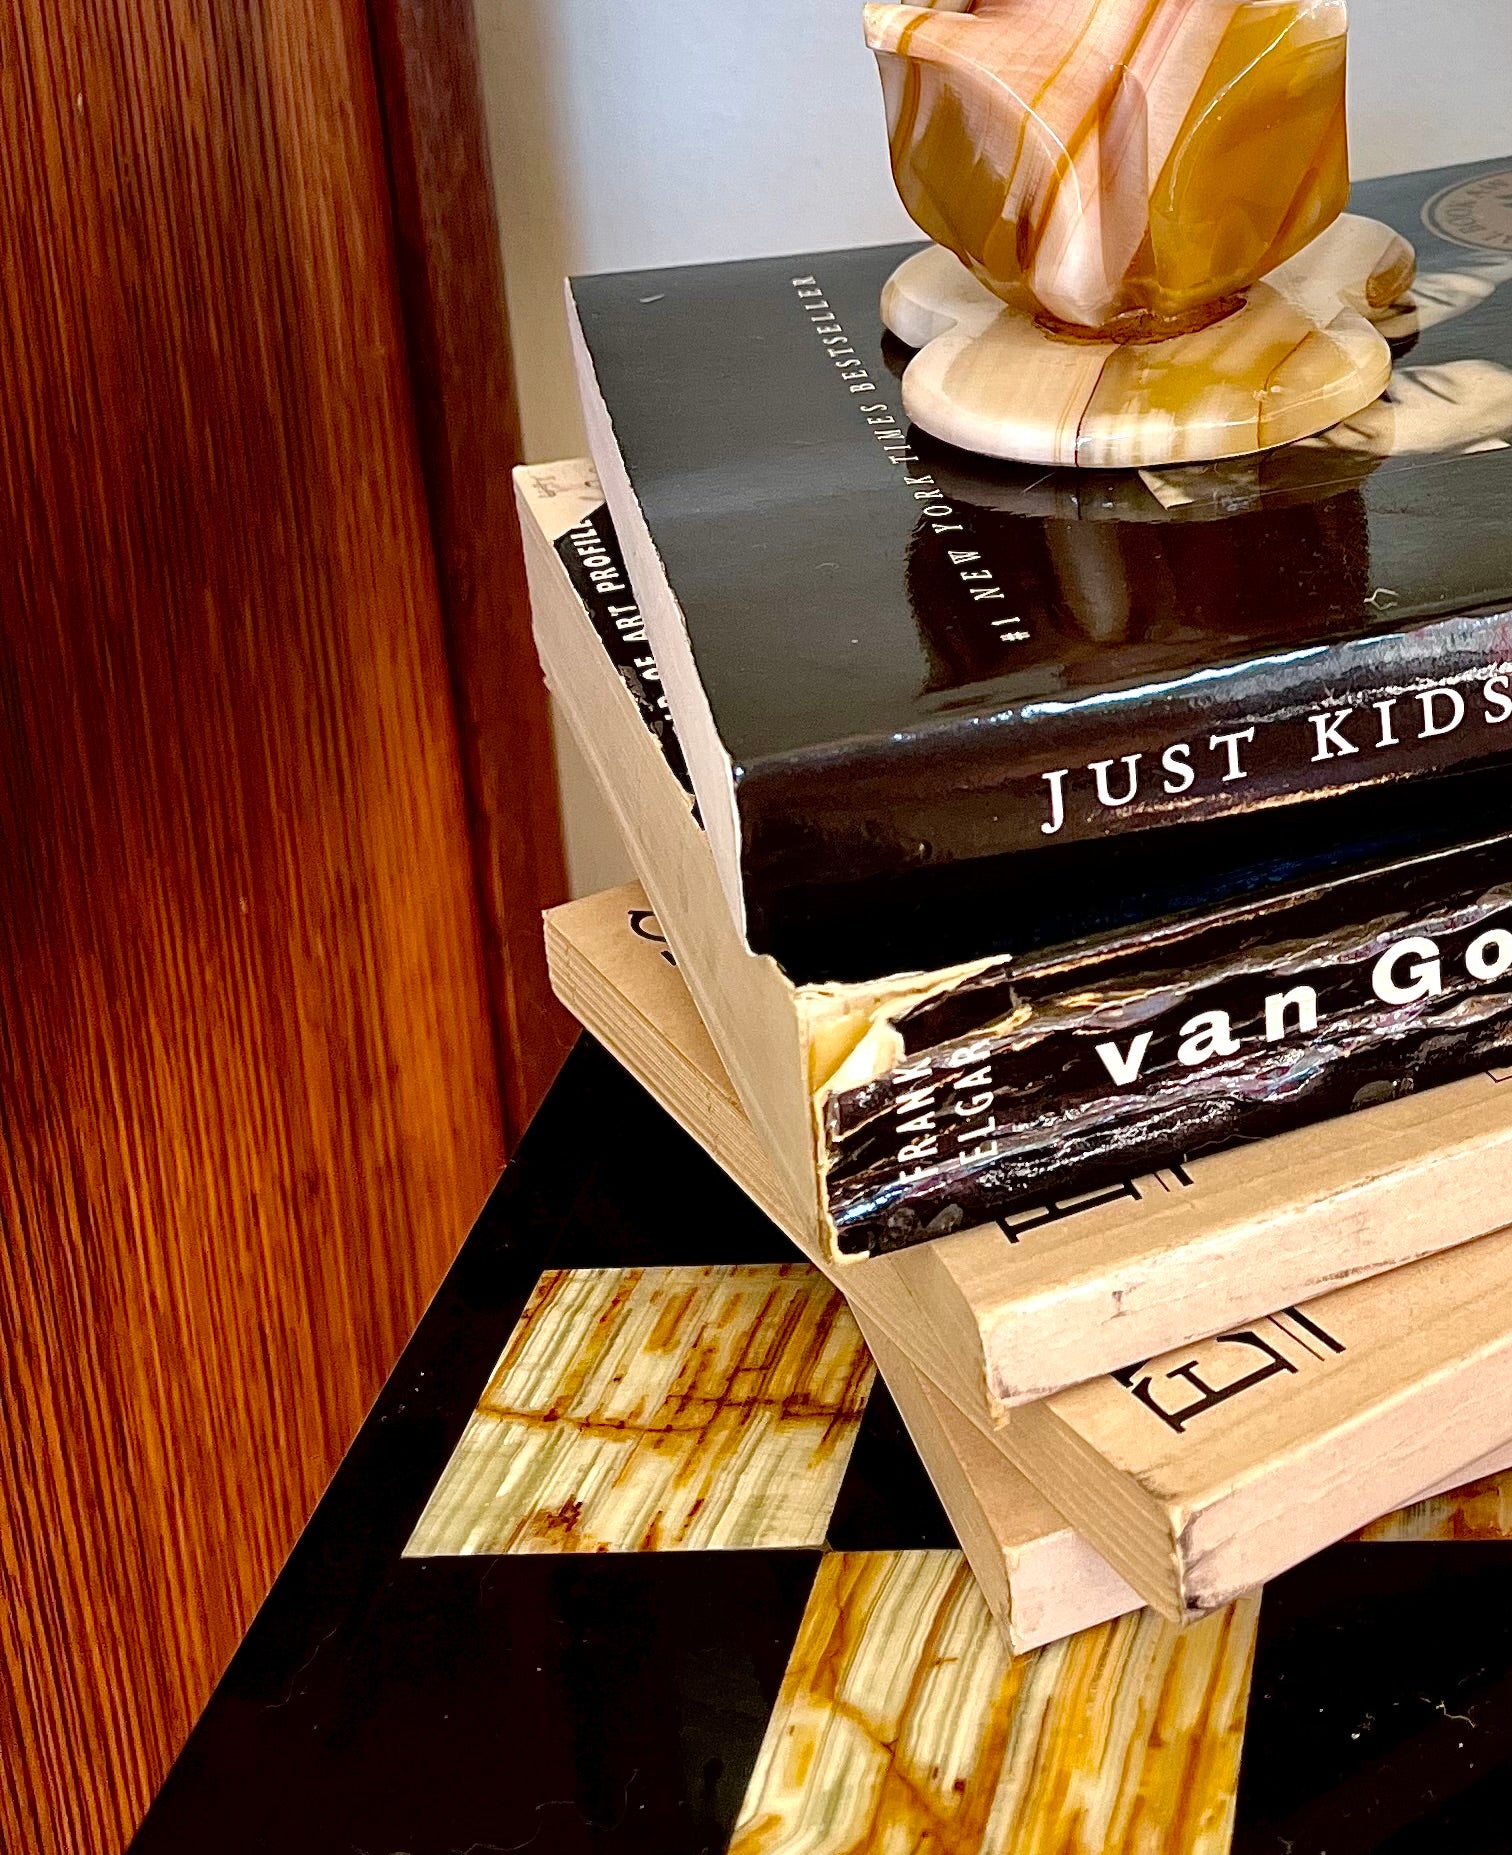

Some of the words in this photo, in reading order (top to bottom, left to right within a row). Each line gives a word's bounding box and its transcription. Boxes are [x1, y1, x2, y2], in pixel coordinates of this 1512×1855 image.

[792, 275, 877, 394] BESTSELLER
[860, 403, 920, 465] TIMES
[903, 475, 964, 534] YORK
[947, 549, 1006, 601] NEW
[607, 605, 648, 642] ART
[991, 616, 1031, 643] #1
[1040, 727, 1256, 836] JUST
[1095, 982, 1319, 1087] van
[892, 1056, 939, 1185] FRANK
[949, 1038, 999, 1166] ELGAR
